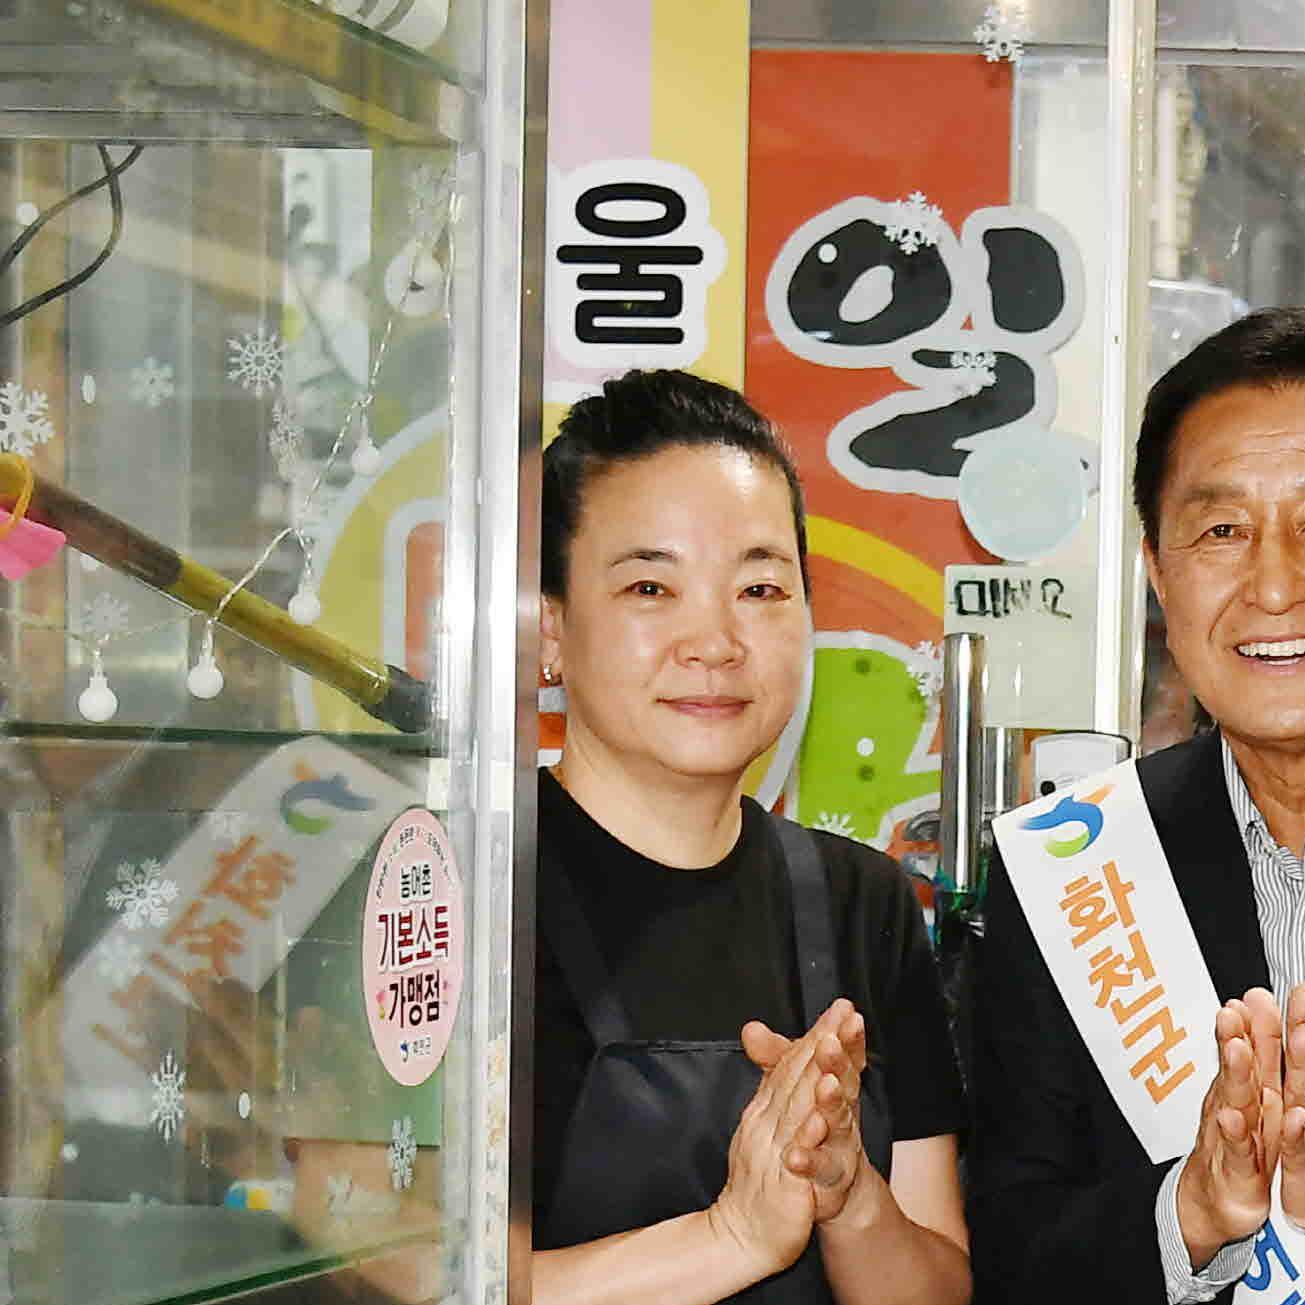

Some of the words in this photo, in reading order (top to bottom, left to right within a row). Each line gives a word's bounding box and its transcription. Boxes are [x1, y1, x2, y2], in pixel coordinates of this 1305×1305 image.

[378, 905, 449, 968] 기본소득
[389, 969, 441, 1029] 가맹점
[1059, 860, 1196, 1106] 화천군
